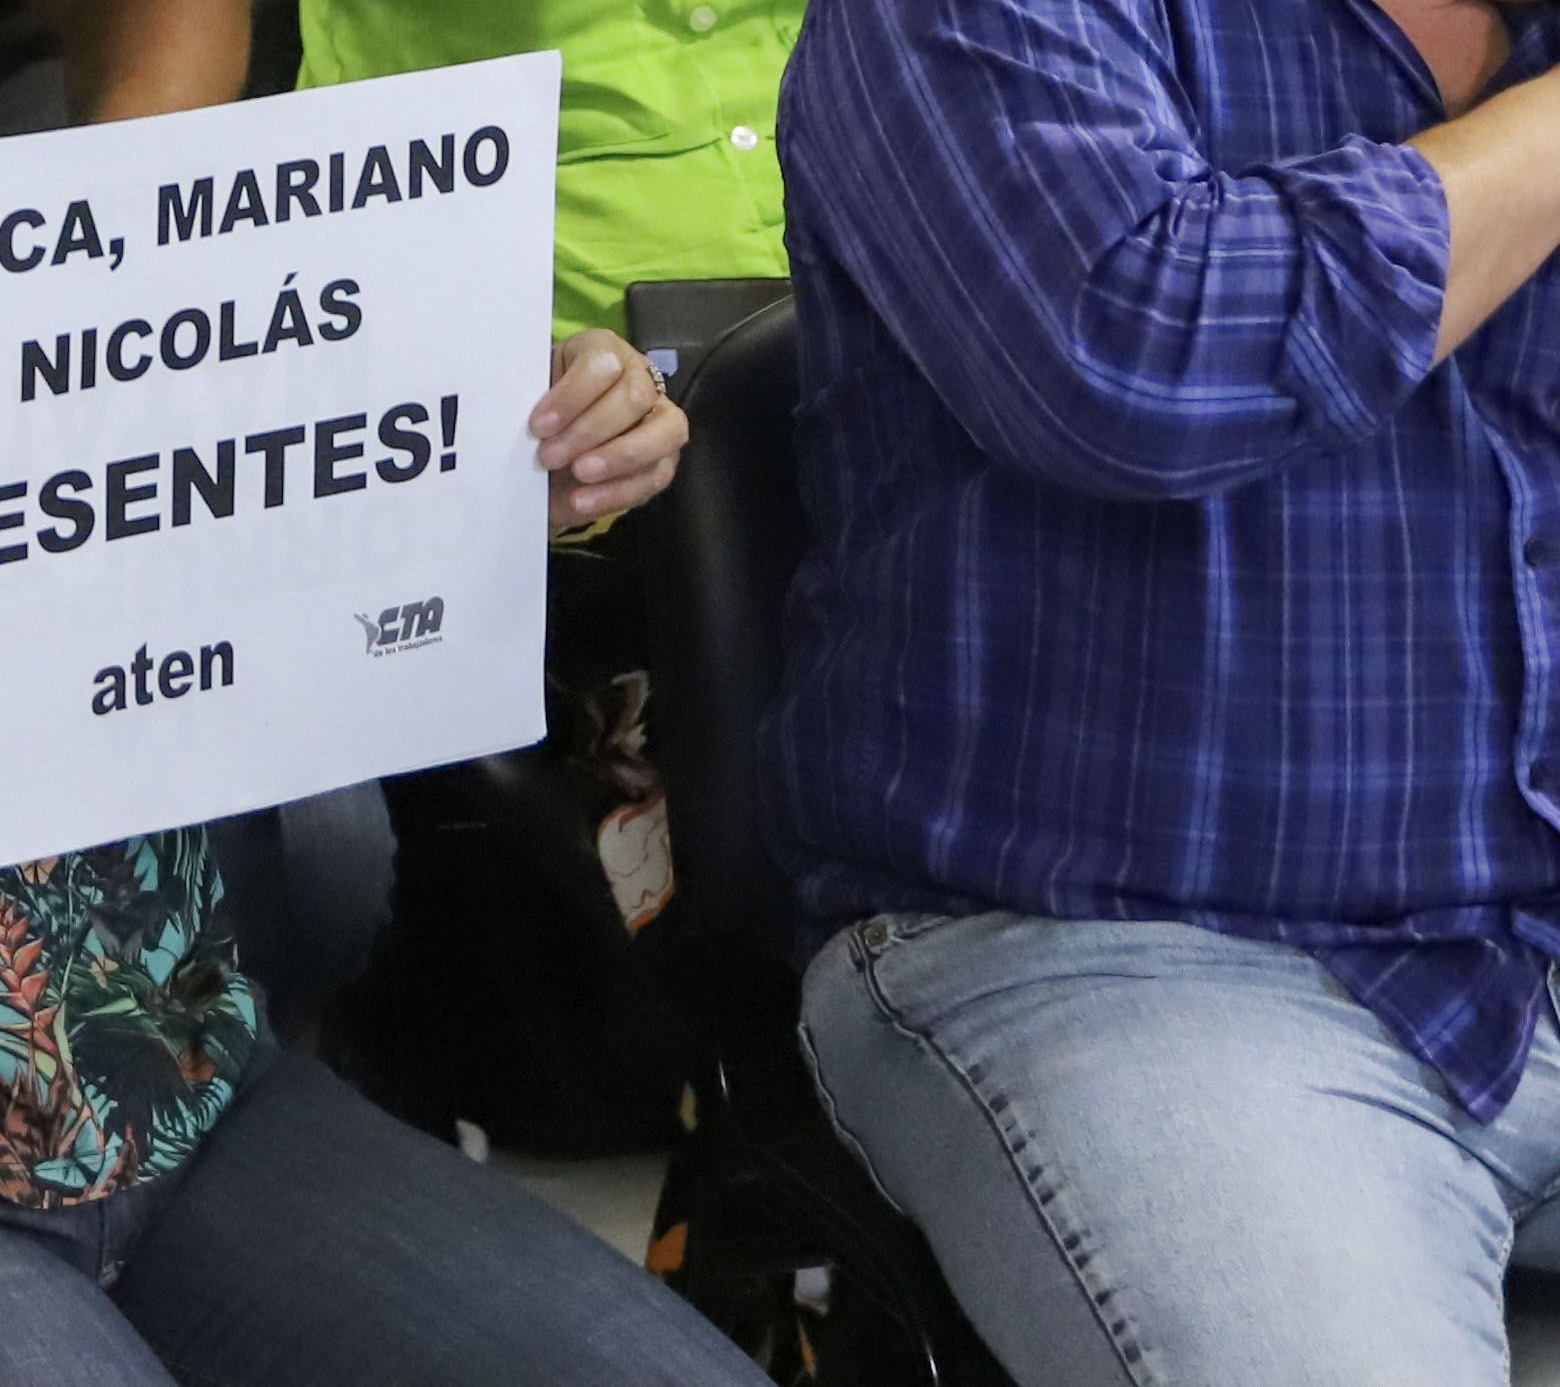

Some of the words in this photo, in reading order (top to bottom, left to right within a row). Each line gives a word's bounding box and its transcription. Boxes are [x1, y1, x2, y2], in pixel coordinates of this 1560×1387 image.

[157, 125, 509, 246] MARIANO
[21, 272, 362, 403] NICOLÁS
[377, 596, 444, 646] CTA
[91, 641, 234, 716] aten
